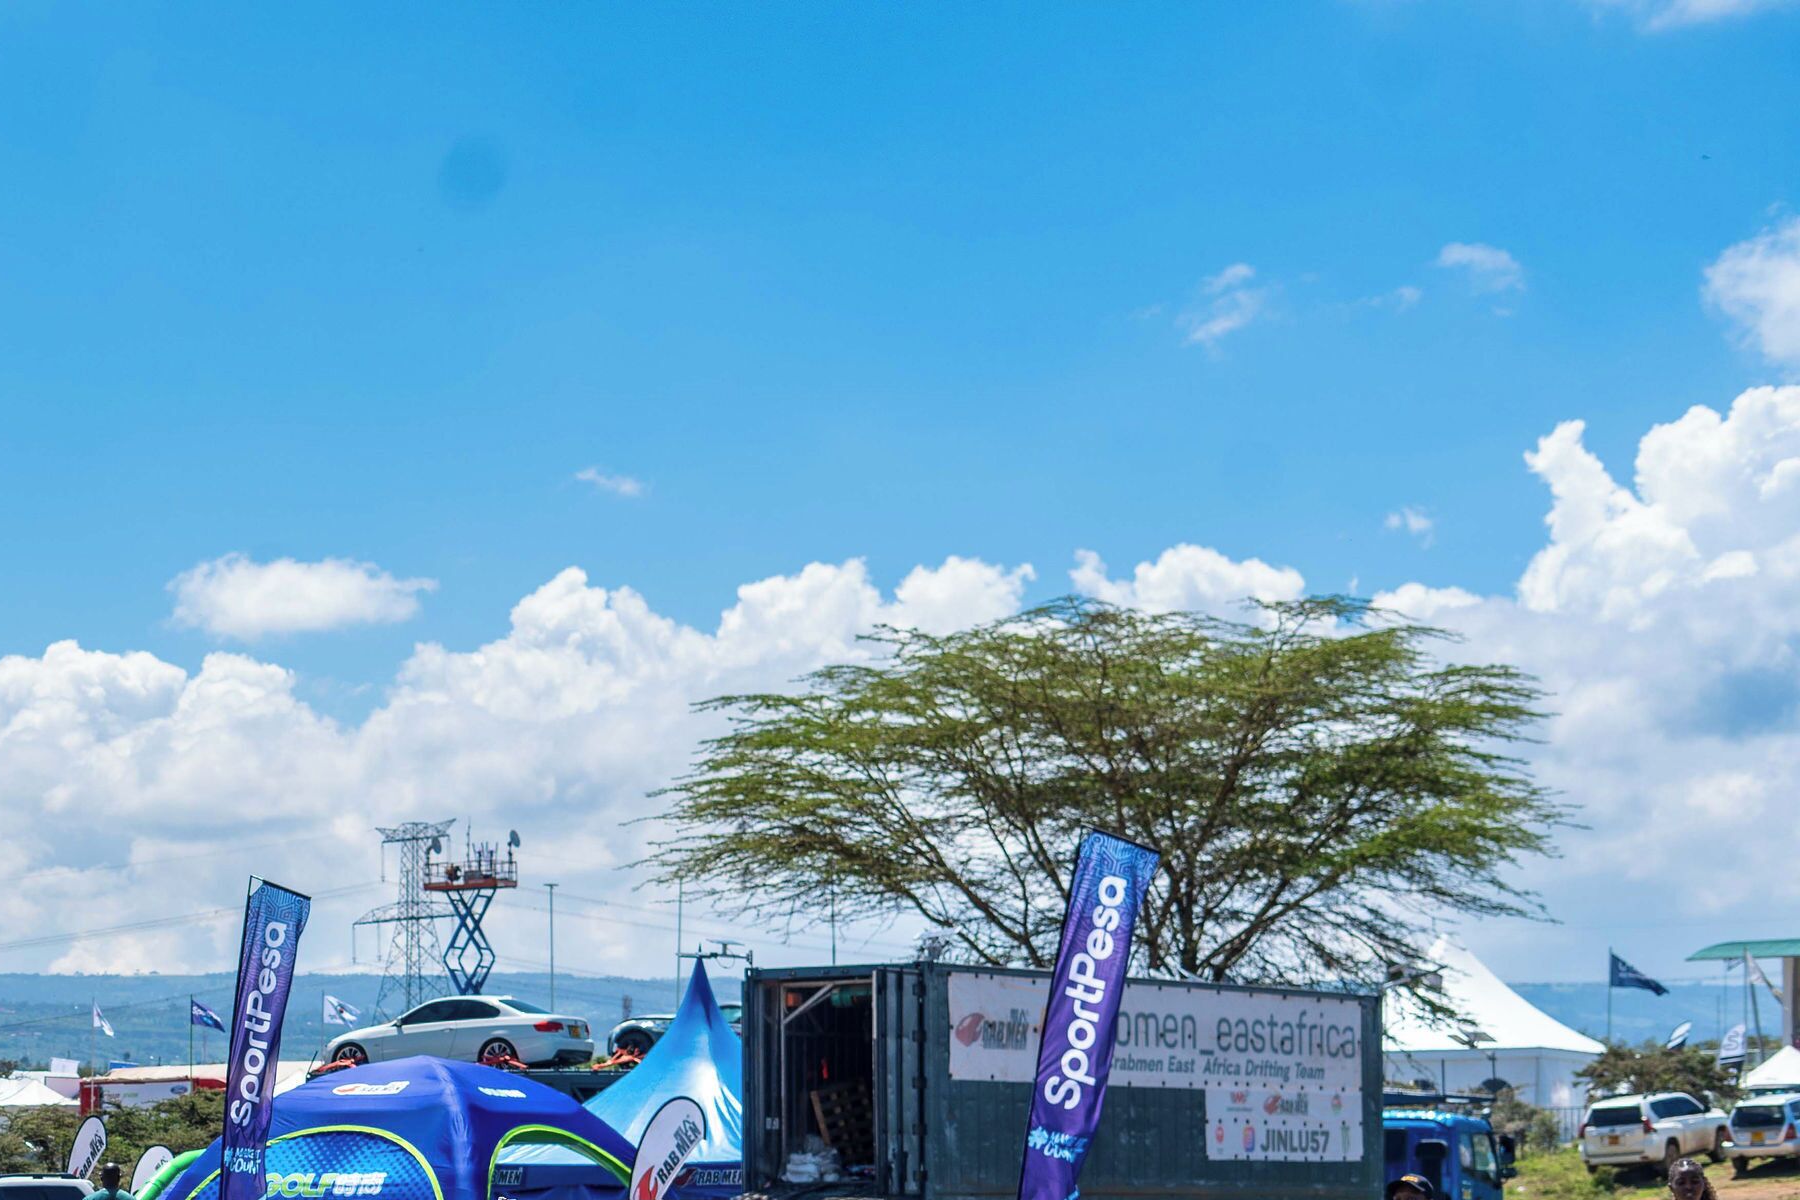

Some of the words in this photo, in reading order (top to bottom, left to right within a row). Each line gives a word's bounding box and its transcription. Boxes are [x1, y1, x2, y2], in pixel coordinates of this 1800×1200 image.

[1044, 875, 1127, 1111] SportPesa
[231, 921, 287, 1128] SportPesa
[1116, 1010, 1356, 1059] omen_eastafrica
[1111, 1054, 1163, 1074] rabmen
[1168, 1056, 1195, 1074] East
[1203, 1059, 1240, 1077] Africa
[1245, 1060, 1290, 1082] Drifting
[1295, 1062, 1325, 1081] Team
[677, 1120, 702, 1158] MEN
[1260, 1128, 1330, 1153] JINLU57
[266, 1173, 338, 1198] GOLF
